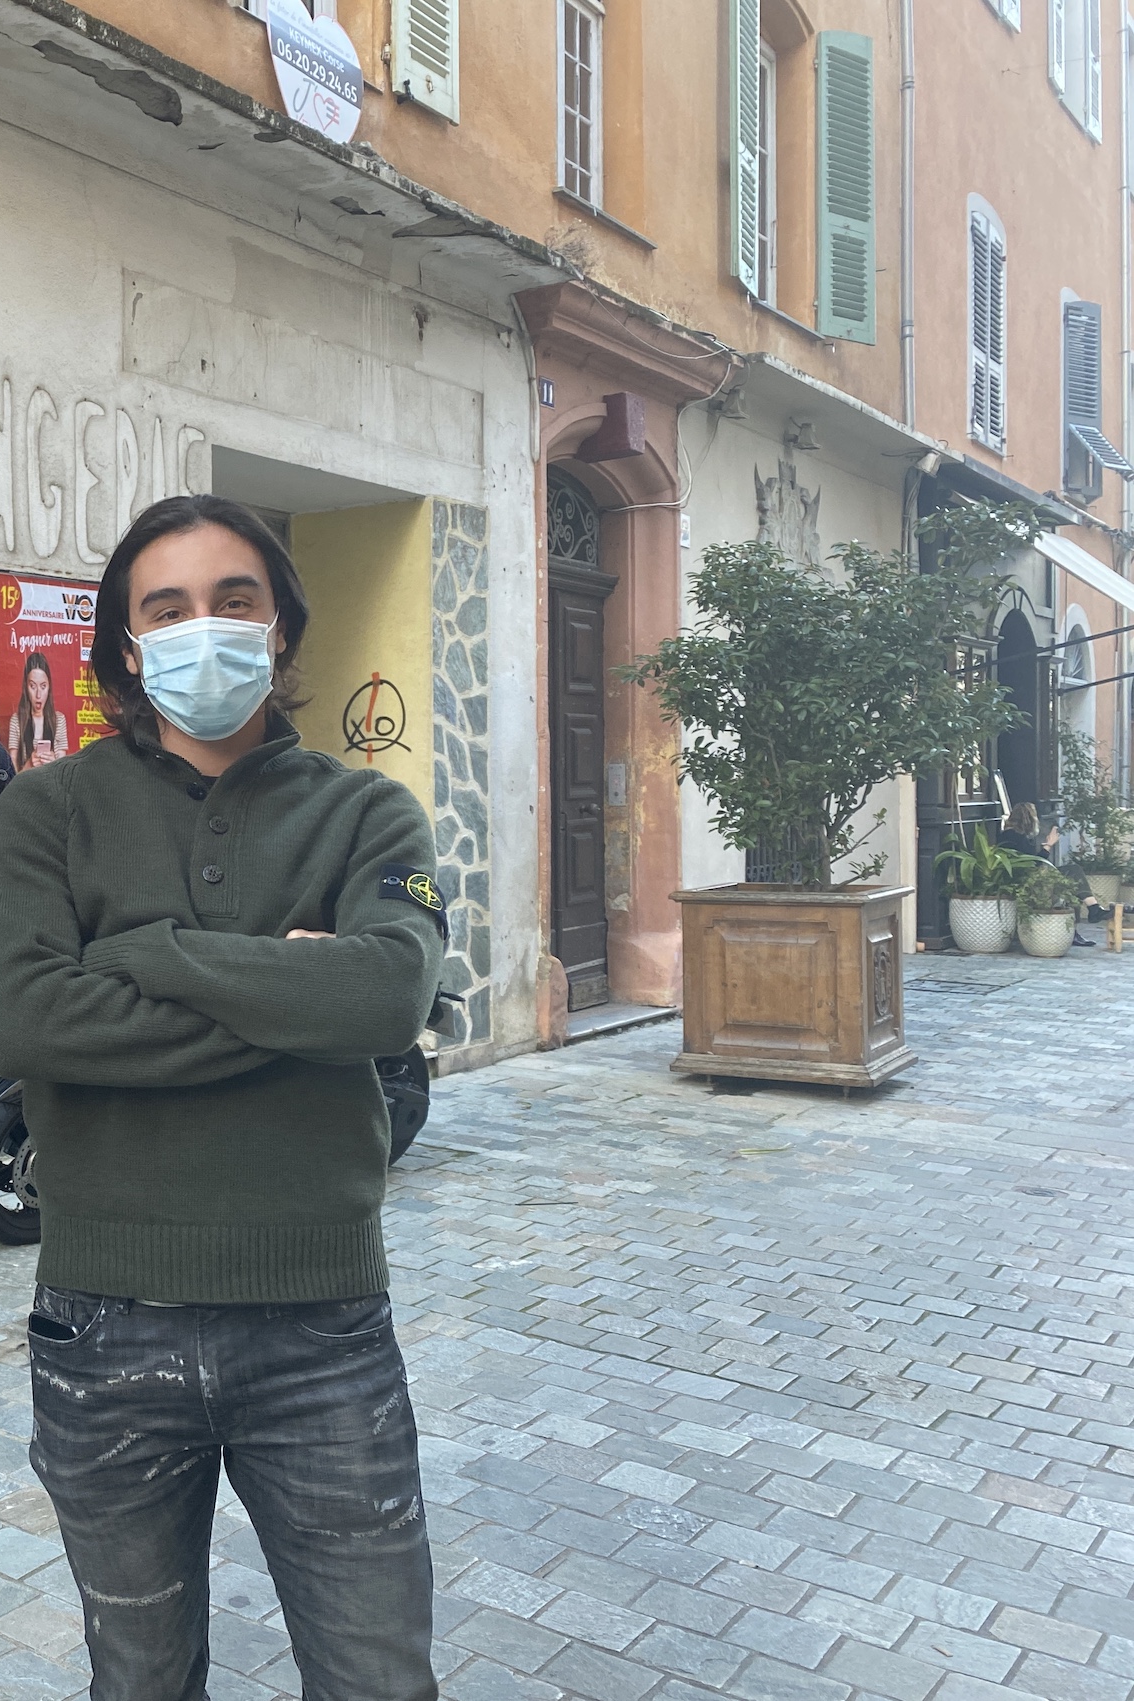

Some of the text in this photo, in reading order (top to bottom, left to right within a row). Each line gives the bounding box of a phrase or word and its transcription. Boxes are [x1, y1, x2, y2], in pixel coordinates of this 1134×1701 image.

[276, 38, 358, 103] 06.20.29.24.65
[543, 382, 553, 404] 11
[22, 608, 65, 620] ANNIVERSAIRE
[10, 627, 18, 649] À
[19, 634, 53, 653] gagner
[53, 633, 74, 645] avec
